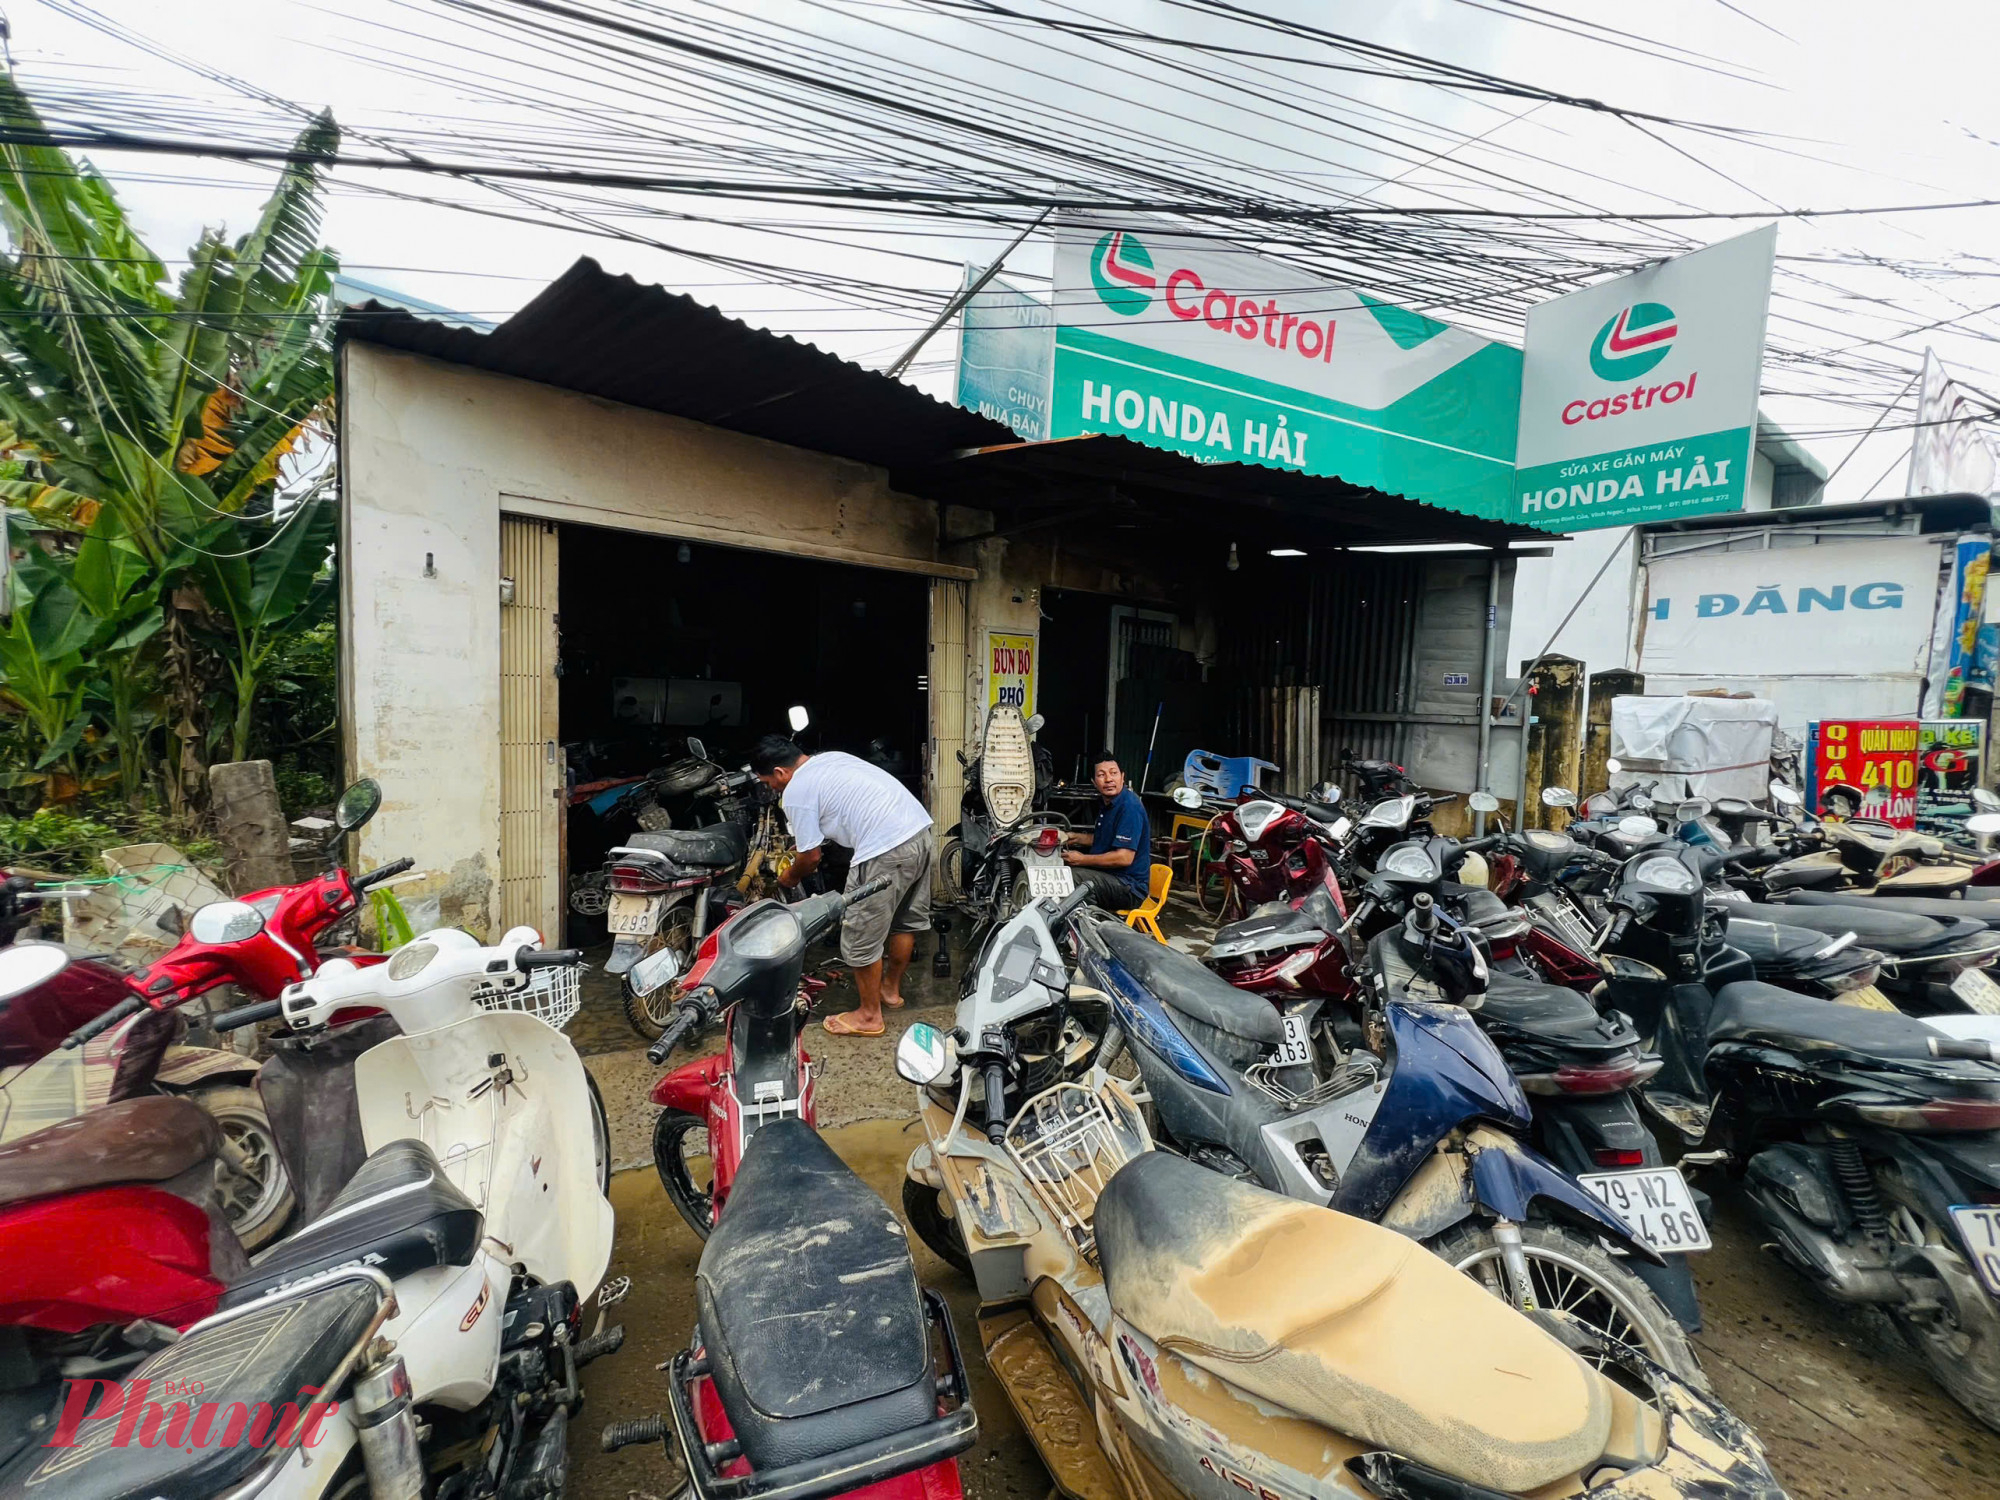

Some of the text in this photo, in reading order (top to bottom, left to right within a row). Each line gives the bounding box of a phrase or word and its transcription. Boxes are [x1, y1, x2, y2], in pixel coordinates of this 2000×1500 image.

[1165, 268, 1337, 364] Castrol
[1561, 371, 1698, 425] Castrol
[979, 400, 1039, 436] MUA BÁN
[1082, 379, 1308, 467] HONDA HẢI
[1560, 463, 1588, 478] SỬA
[1592, 459, 1610, 472] XE
[1650, 446, 1685, 463] MÁY
[1521, 455, 1731, 514] HONDA HẢI
[1694, 581, 1905, 619] ĐĂNG
[993, 641, 1031, 675] BÚN BÒ
[999, 679, 1025, 707] PHỞ
[1861, 725, 1888, 754] QUÁN
[1890, 725, 1917, 756] NHẬU
[1861, 760, 1914, 789] 410
[1886, 792, 1914, 823] LỘN
[1034, 869, 1065, 881] 79-AA
[1035, 882, 1070, 895] 353.31
[1344, 1113, 1371, 1128] HON
[1595, 1175, 1677, 1209] 79-N2
[1621, 1210, 1701, 1246] 4.86
